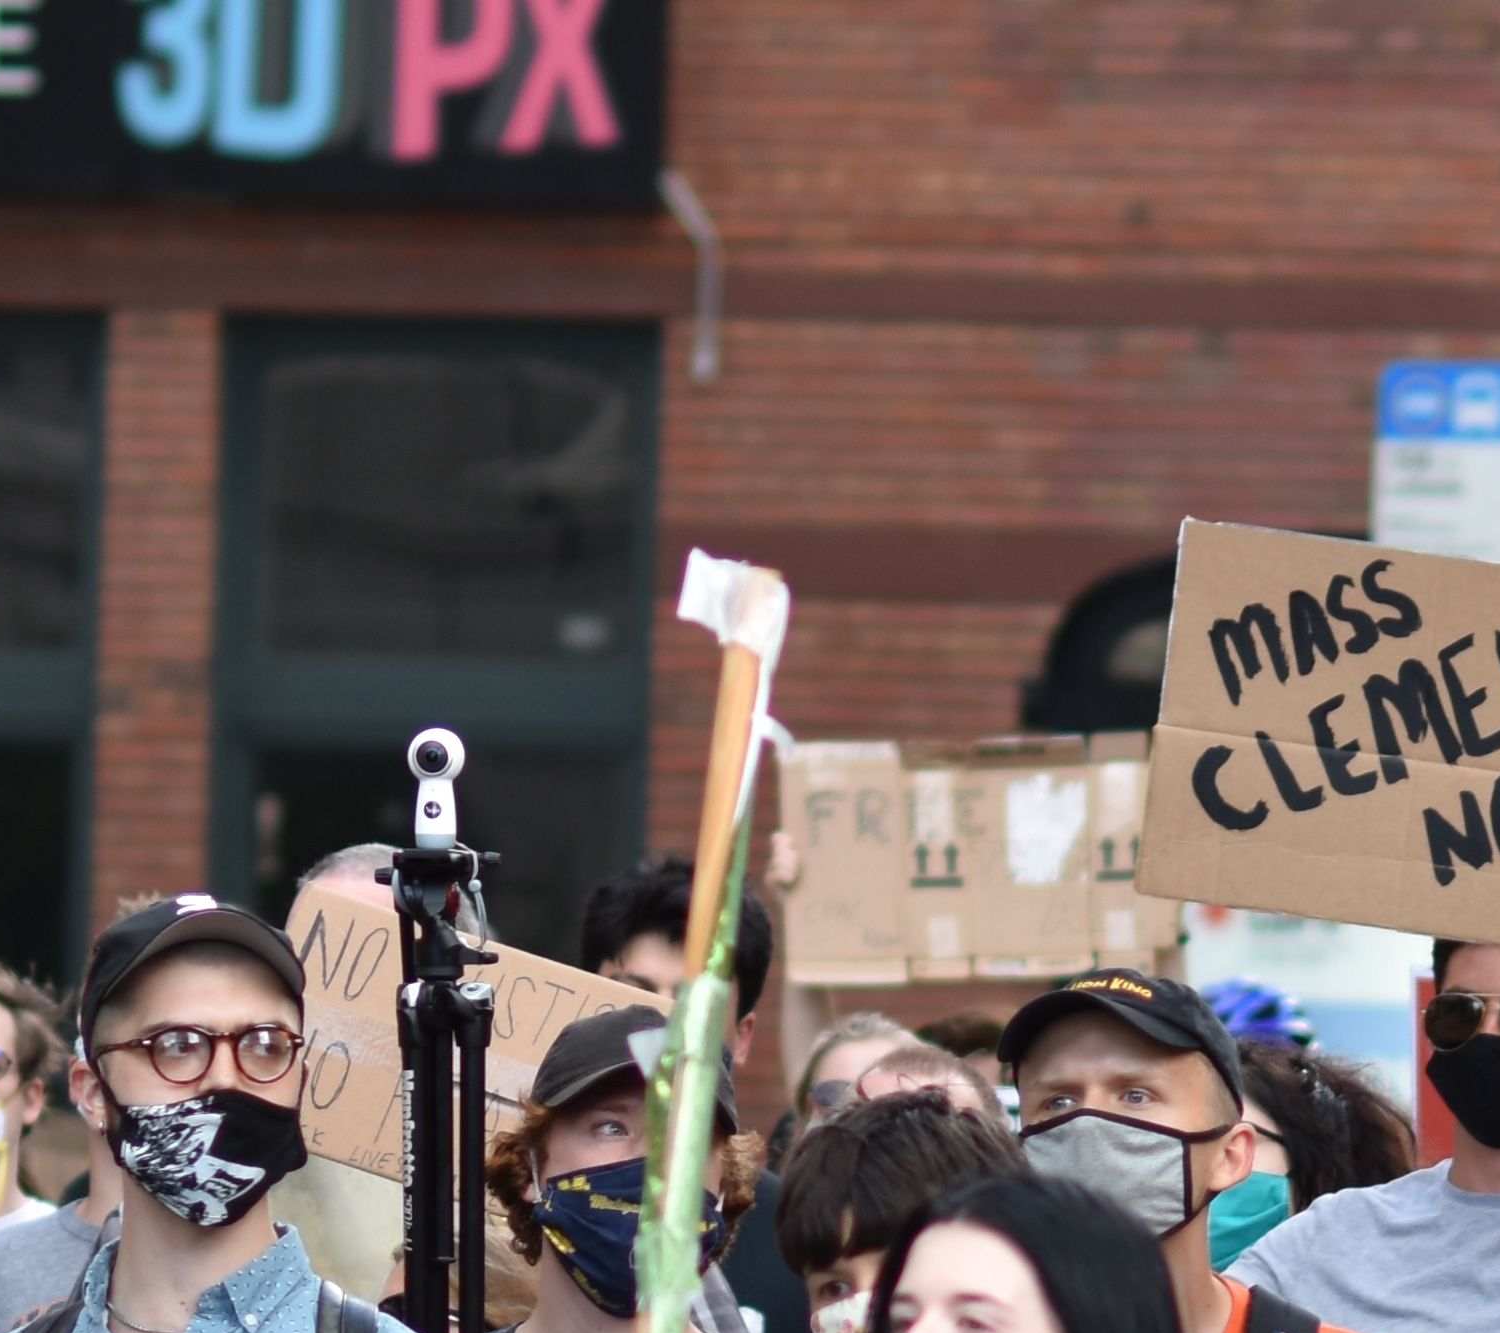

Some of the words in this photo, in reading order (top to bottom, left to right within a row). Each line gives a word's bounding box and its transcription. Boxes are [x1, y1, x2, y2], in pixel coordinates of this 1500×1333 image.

[1207, 559, 1422, 706] MASS
[301, 908, 390, 1001] NO
[1109, 977, 1153, 999] KING
[402, 1069, 416, 1188] Manfrotto
